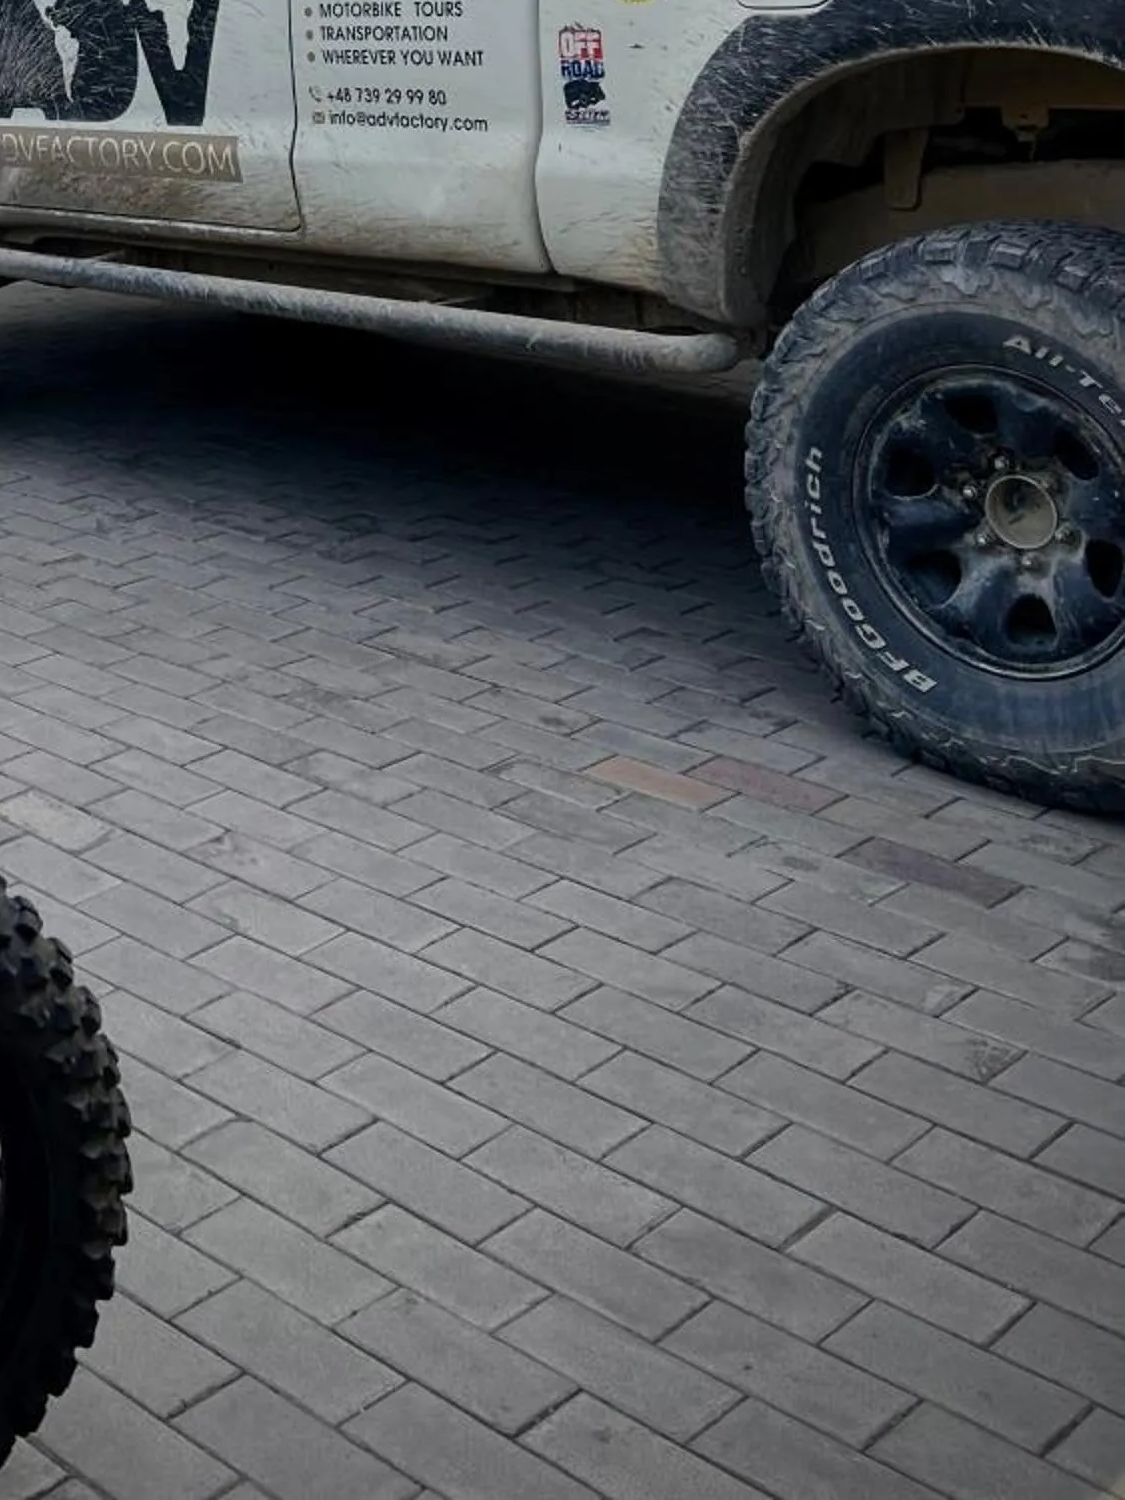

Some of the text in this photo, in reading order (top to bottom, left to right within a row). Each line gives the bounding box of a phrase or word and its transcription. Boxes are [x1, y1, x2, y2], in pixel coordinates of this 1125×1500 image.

[319, 1, 464, 18] MOTORBIKE TOURS
[320, 25, 448, 42] TRANSPORTATION
[322, 49, 484, 67] WHEREVER YOU WANT
[327, 87, 447, 106] +48 739 29 99 80
[329, 109, 489, 133] info@advfactory.com
[1002, 334, 1125, 427] All-Te
[804, 446, 939, 694] BFGoodrich
